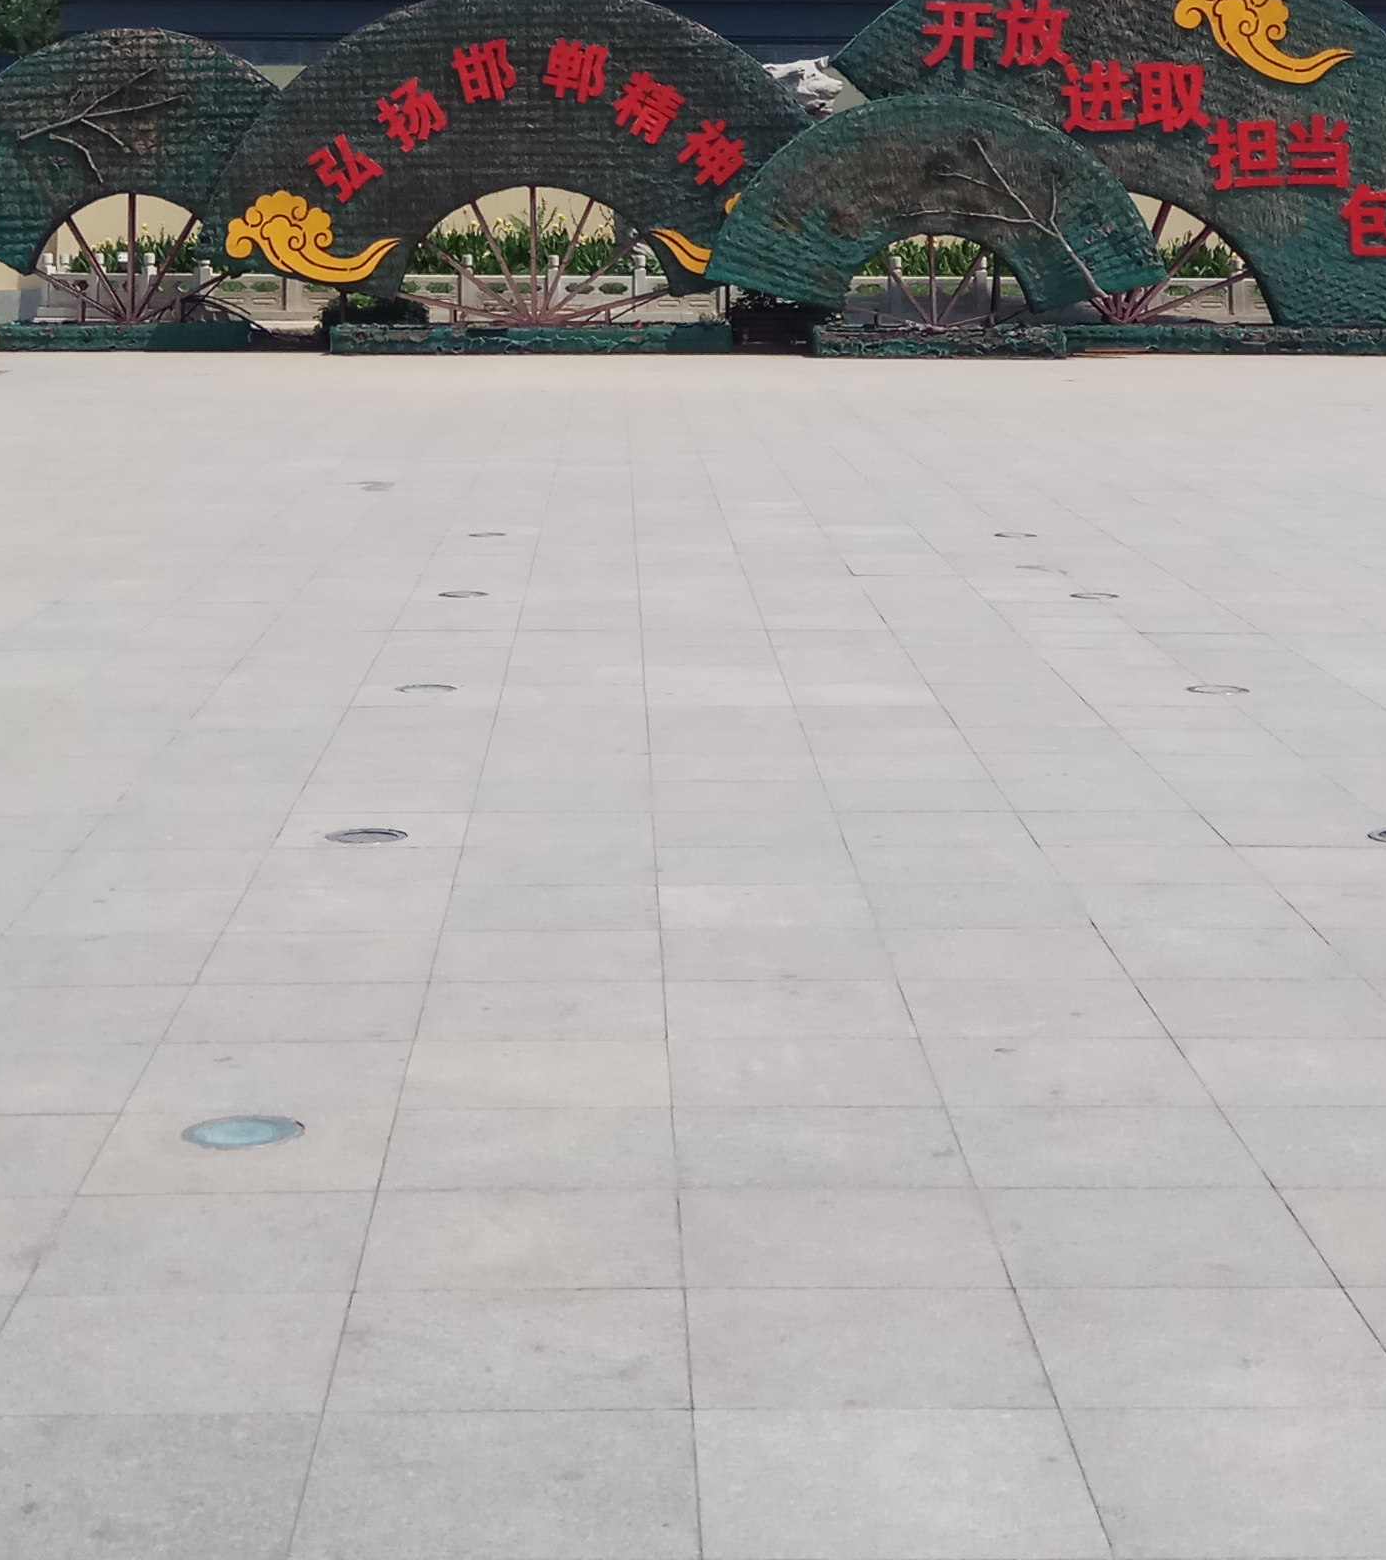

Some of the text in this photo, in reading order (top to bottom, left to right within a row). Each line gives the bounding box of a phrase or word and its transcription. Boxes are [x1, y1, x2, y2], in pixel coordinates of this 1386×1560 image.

[308, 38, 745, 203] 弘扬邯郸精神
[1061, 60, 1212, 133] 进取
[1207, 114, 1350, 191] 担当
